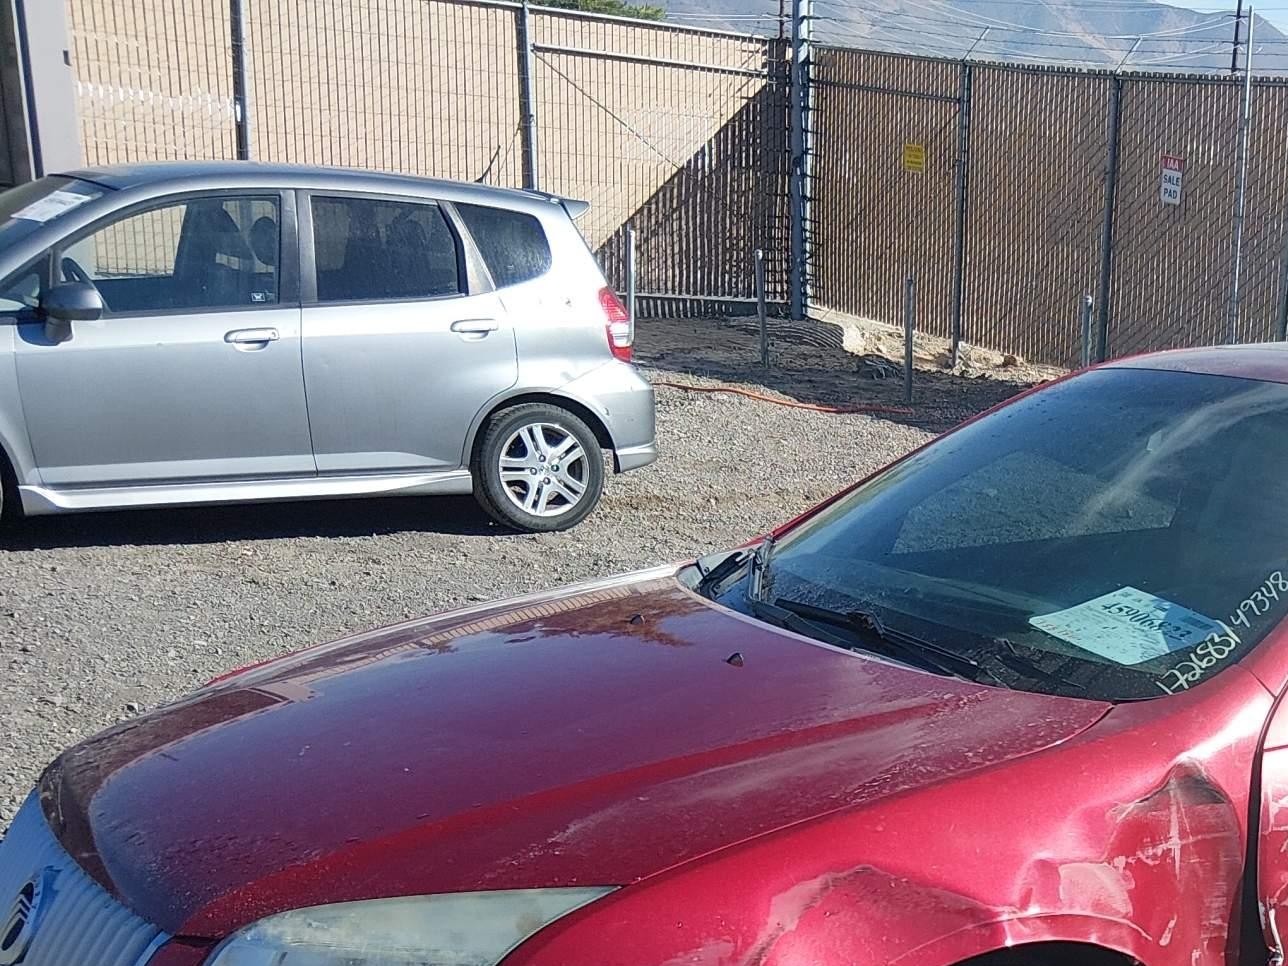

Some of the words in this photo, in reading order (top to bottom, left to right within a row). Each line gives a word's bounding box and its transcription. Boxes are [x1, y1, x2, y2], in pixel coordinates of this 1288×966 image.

[1167, 158, 1179, 170] IAA
[1163, 174, 1180, 186] SALE
[1163, 188, 1178, 199] PAD
